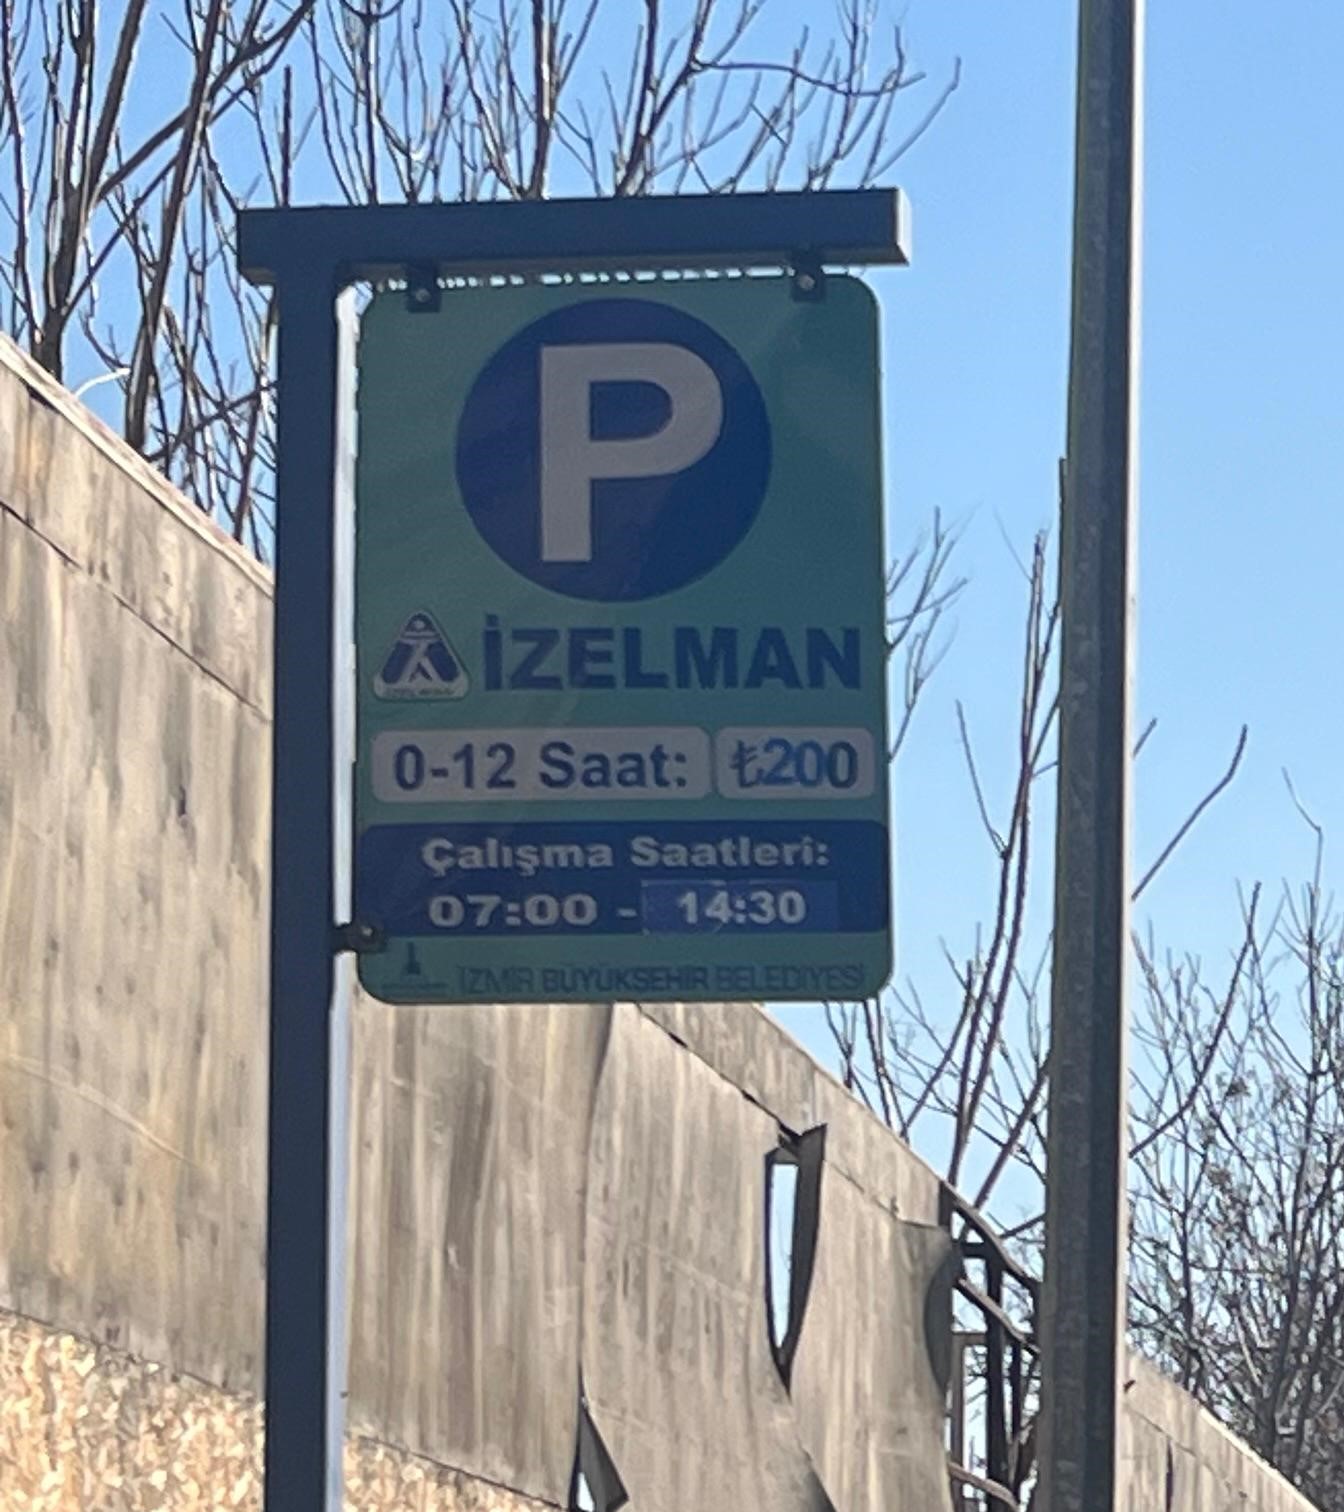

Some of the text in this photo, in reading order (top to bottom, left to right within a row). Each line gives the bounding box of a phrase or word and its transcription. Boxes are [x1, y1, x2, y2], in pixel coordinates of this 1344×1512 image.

[538, 341, 725, 563] P
[483, 614, 863, 692] İZELMAN
[393, 738, 859, 791] 0-12 Saat: ₺200
[421, 835, 831, 877] Çalışma Saatleri:
[428, 893, 599, 928] 07:00
[677, 889, 808, 926] 14:30
